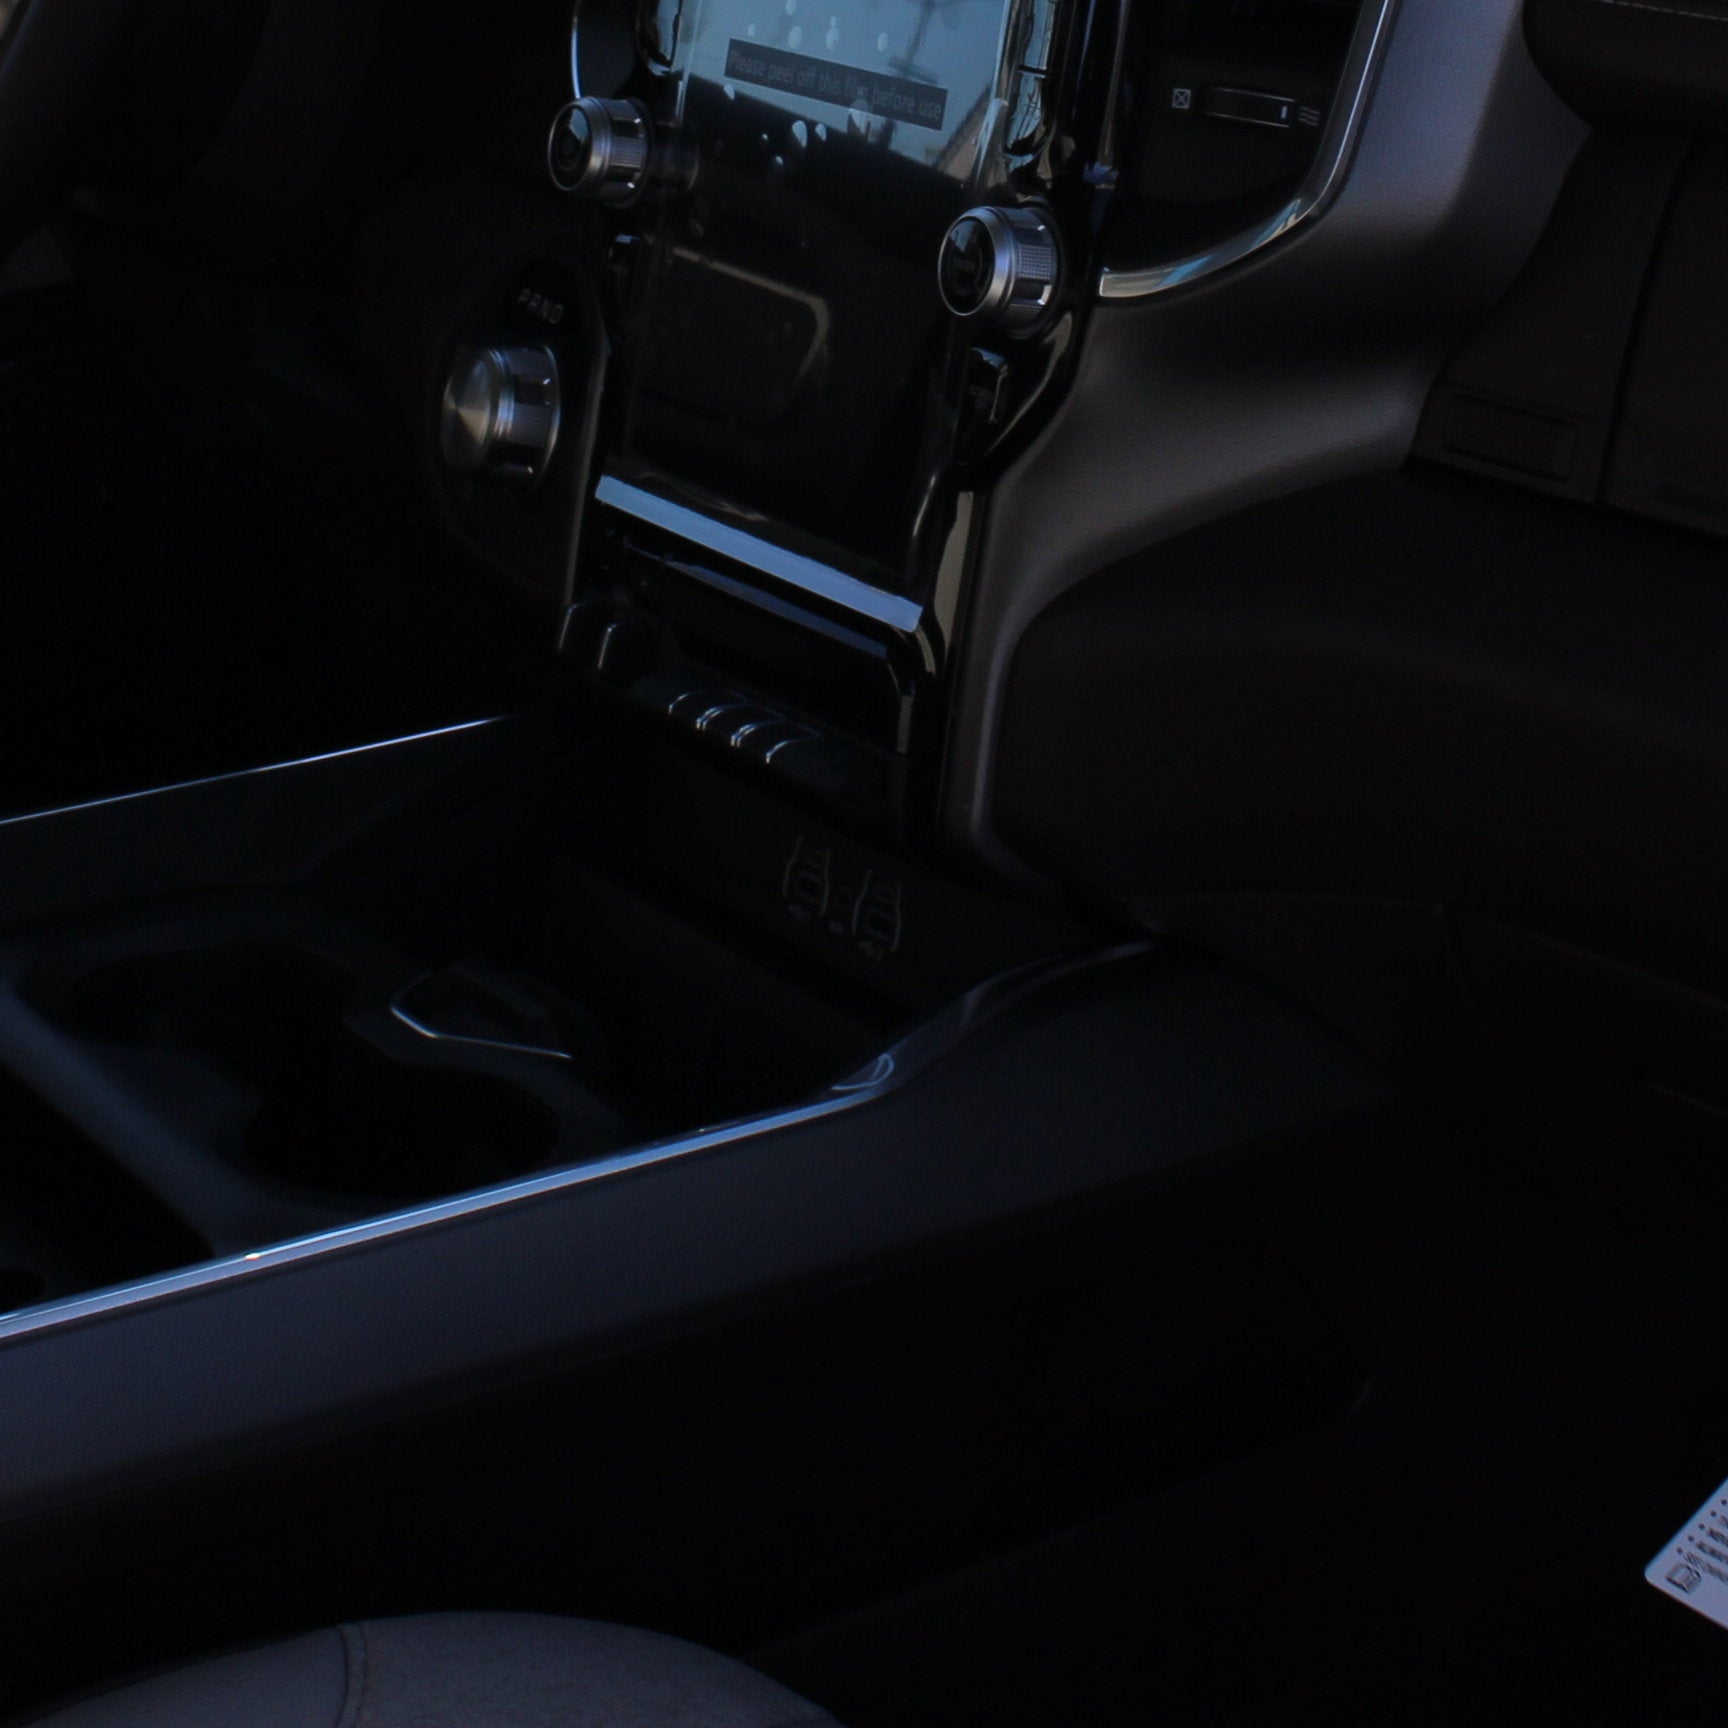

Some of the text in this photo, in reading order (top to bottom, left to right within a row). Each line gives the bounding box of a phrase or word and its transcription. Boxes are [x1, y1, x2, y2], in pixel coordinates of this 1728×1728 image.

[768, 59, 794, 84] peel
[796, 67, 817, 87] off
[818, 70, 842, 93] this
[872, 83, 917, 111] before
[919, 98, 942, 118] use
